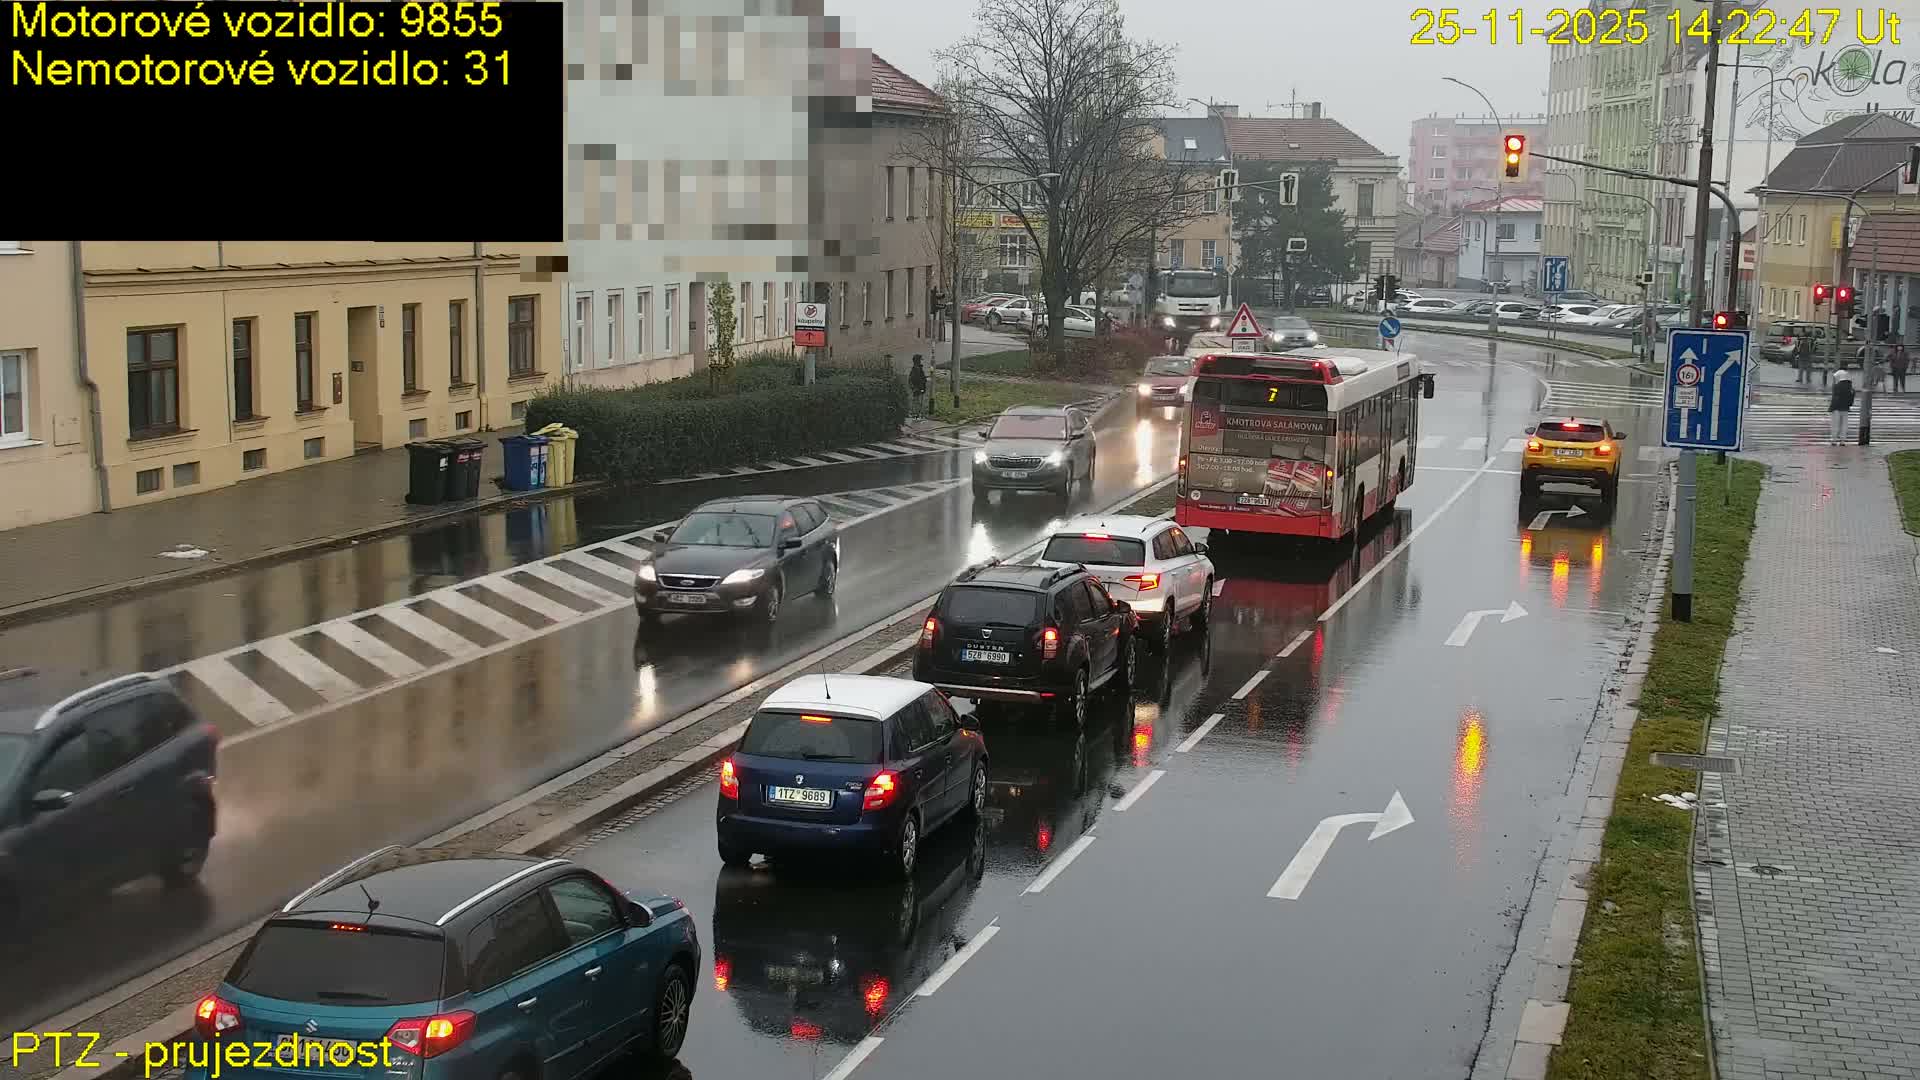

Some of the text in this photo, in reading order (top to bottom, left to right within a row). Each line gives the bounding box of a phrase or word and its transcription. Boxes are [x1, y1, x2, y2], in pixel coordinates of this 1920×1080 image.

[1268, 387, 1279, 402] 7
[1226, 417, 1272, 429] KMOTROVA
[967, 650, 1006, 662] 5Z8 6990
[778, 788, 826, 802] 1TZ 9689
